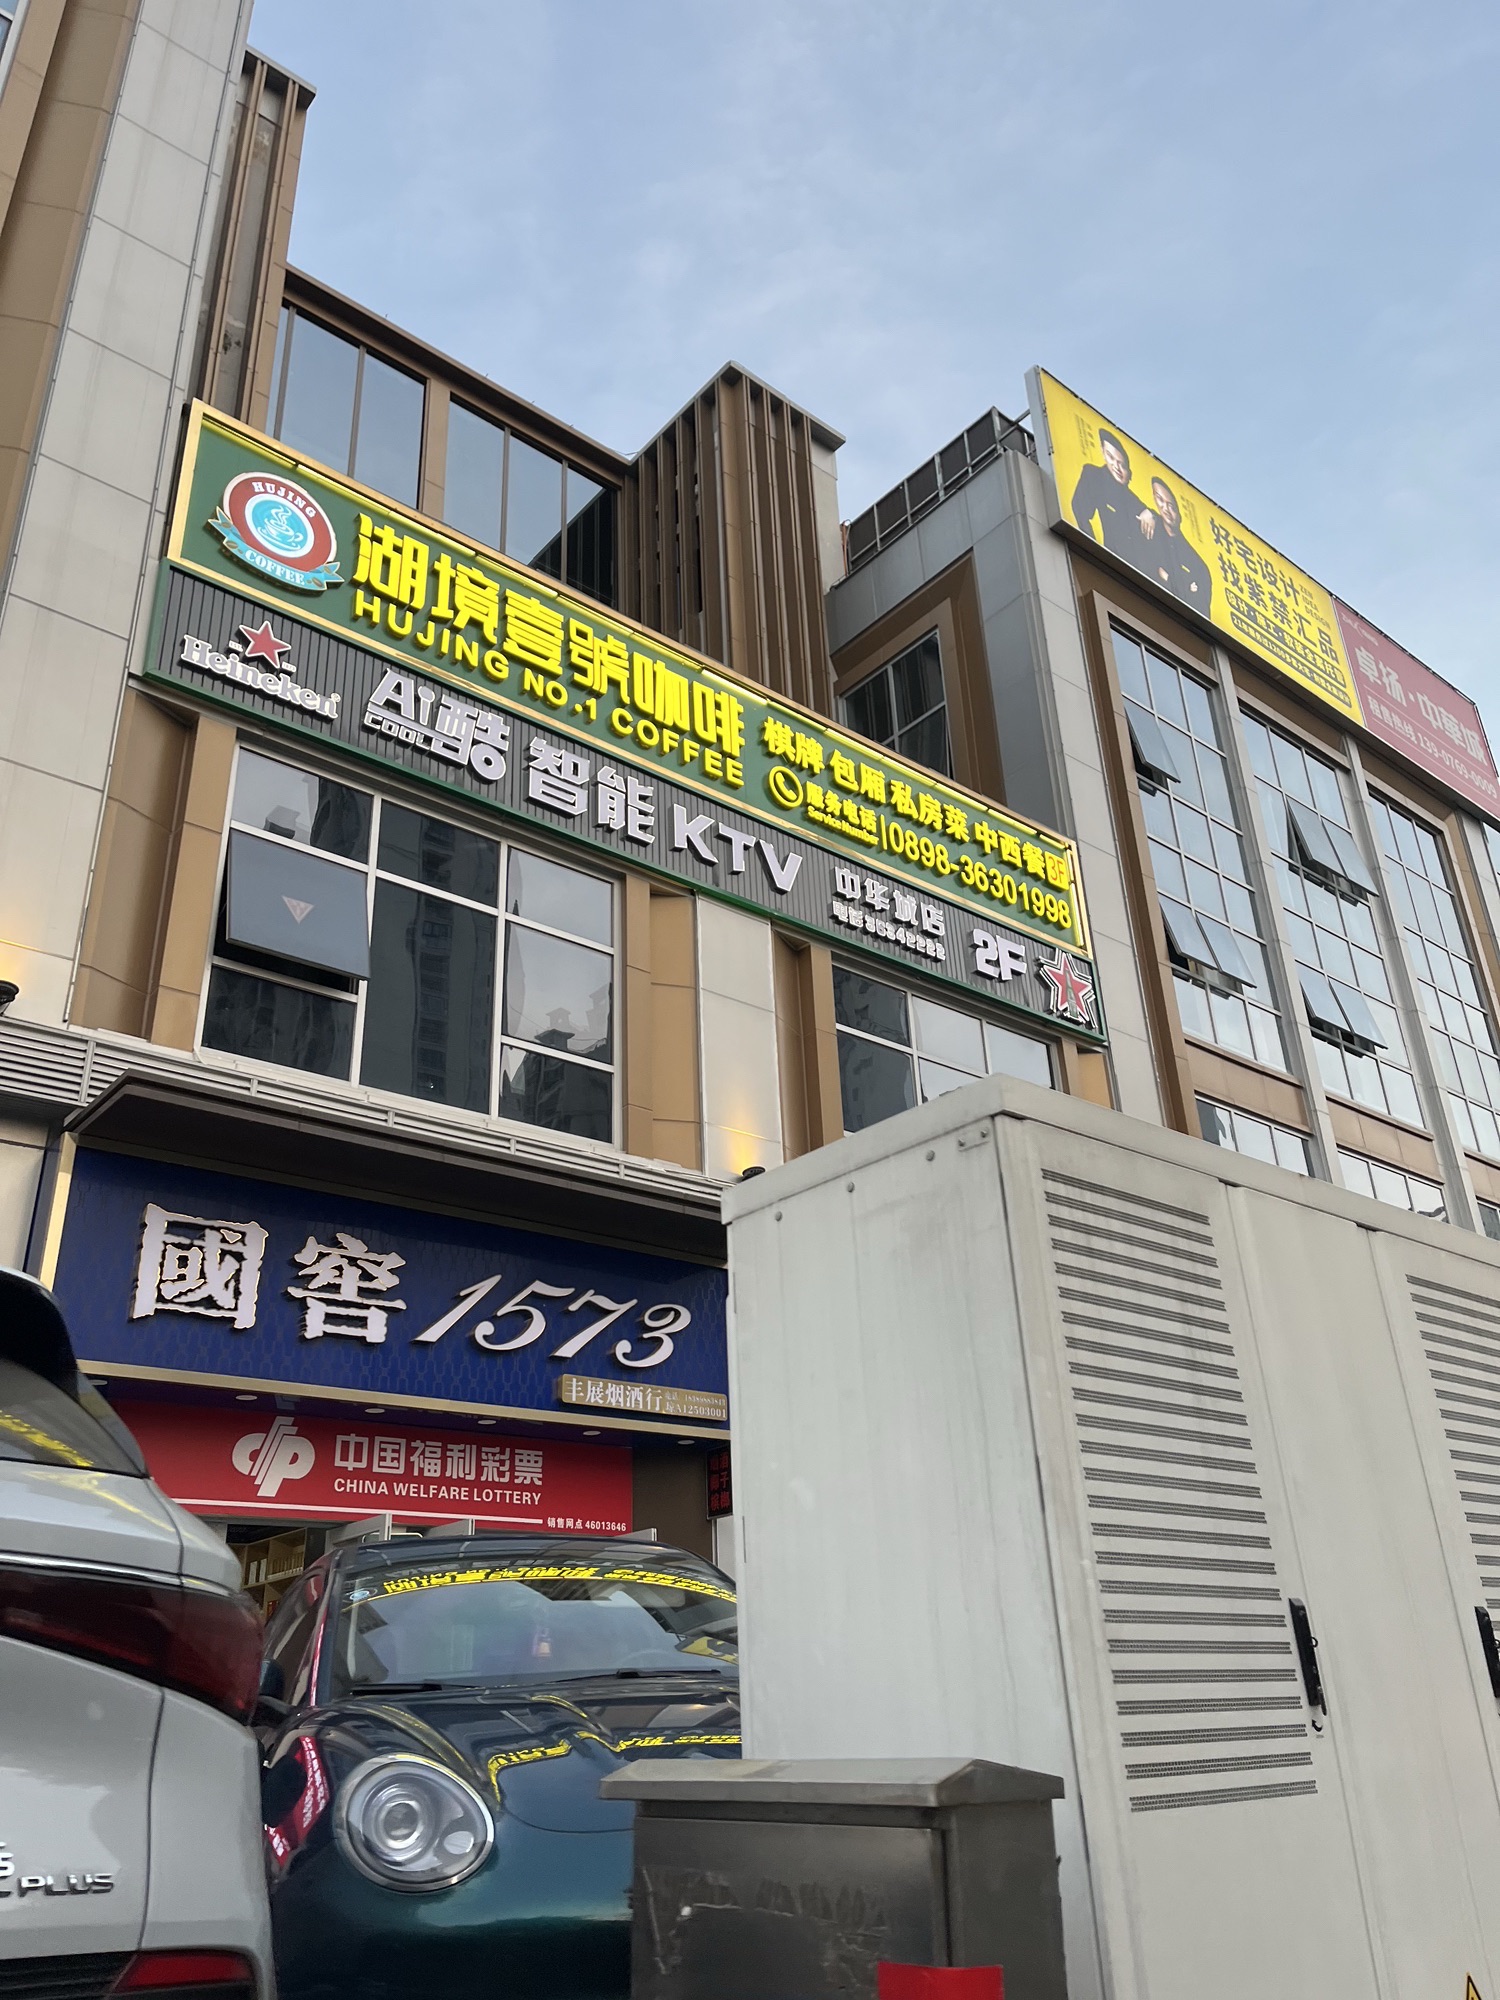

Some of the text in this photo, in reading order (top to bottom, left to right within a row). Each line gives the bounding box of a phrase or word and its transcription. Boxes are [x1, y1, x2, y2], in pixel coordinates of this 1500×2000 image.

[252, 481, 317, 518] HUJING
[245, 549, 306, 586] COFFEE
[1209, 516, 1300, 607] 好宅设计
[1218, 552, 1340, 665] 找紫禁汇品
[1300, 584, 1314, 600] ZEN
[1302, 595, 1319, 612] IDEA
[353, 513, 745, 759] 湖境壹號咖啡
[181, 635, 338, 718] Heineken
[354, 588, 510, 680] HUJING
[610, 707, 745, 789] COFFEE
[1367, 694, 1417, 745] 租售热线
[528, 736, 655, 845] 智能
[673, 803, 803, 893] KTV
[764, 716, 1066, 884] 棋牌 包厢 私房菜 中西餐 3F
[806, 780, 877, 833] 服务电话
[835, 866, 945, 936] 中华城店
[888, 821, 1072, 929] 0898-36301998
[973, 928, 1027, 980] 2F
[565, 1377, 663, 1412] 丰展烟酒行
[334, 1433, 543, 1485] 中国福利彩票
[334, 1478, 542, 1506] CHINA WELFARE LOTTERY
[547, 1517, 627, 1532] 销售网点 46013646
[18, 1873, 114, 1898] PLUS
